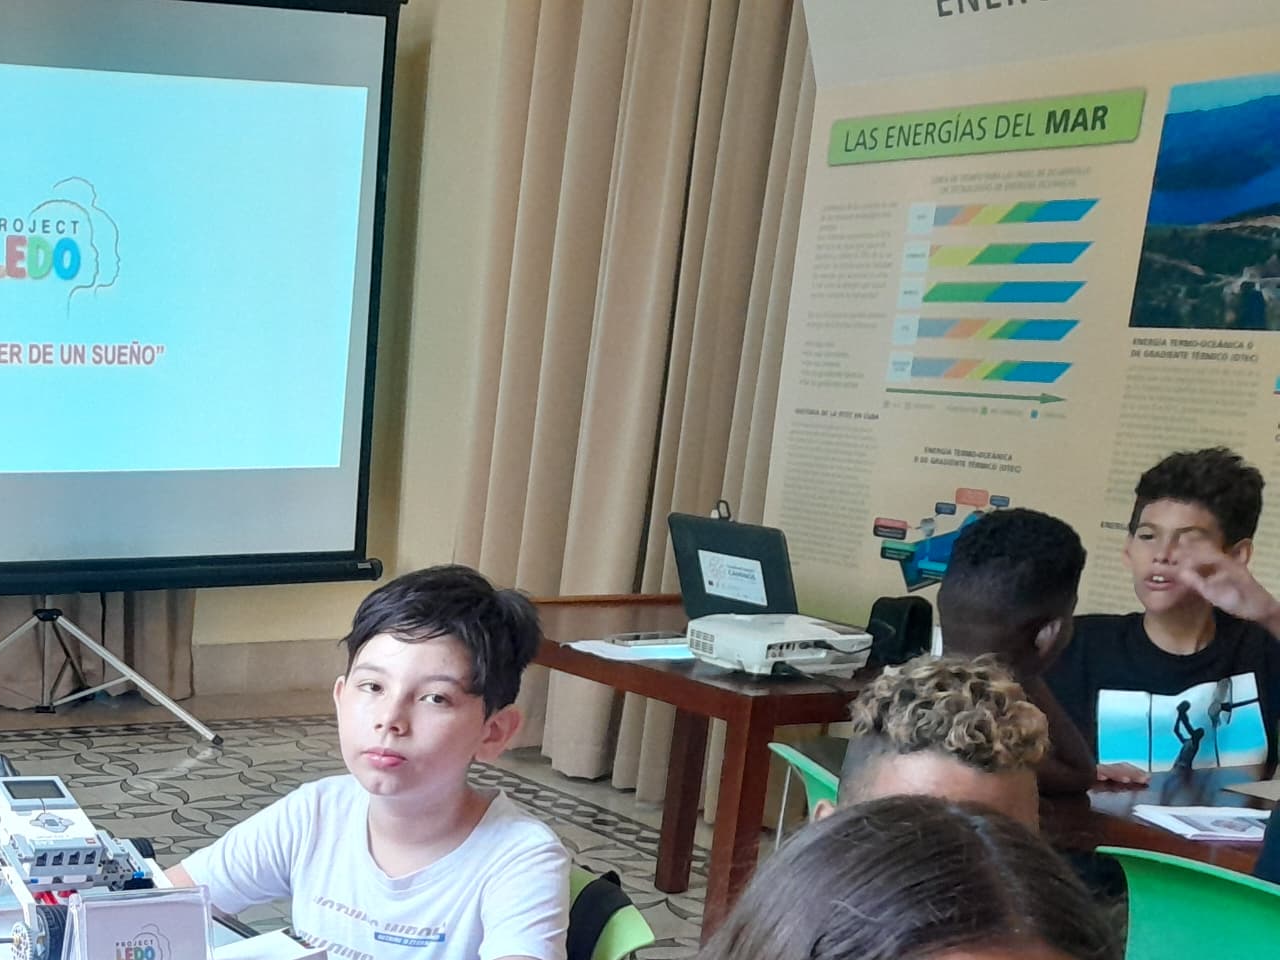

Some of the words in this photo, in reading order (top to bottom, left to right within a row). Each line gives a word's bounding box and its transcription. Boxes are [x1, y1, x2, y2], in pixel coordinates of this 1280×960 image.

[843, 126, 878, 153] LAS
[884, 112, 987, 149] ENERGÍAS
[994, 112, 1035, 140] DEL
[1044, 104, 1108, 135] MAR
[29, 344, 53, 365] DE
[60, 344, 86, 365] UN
